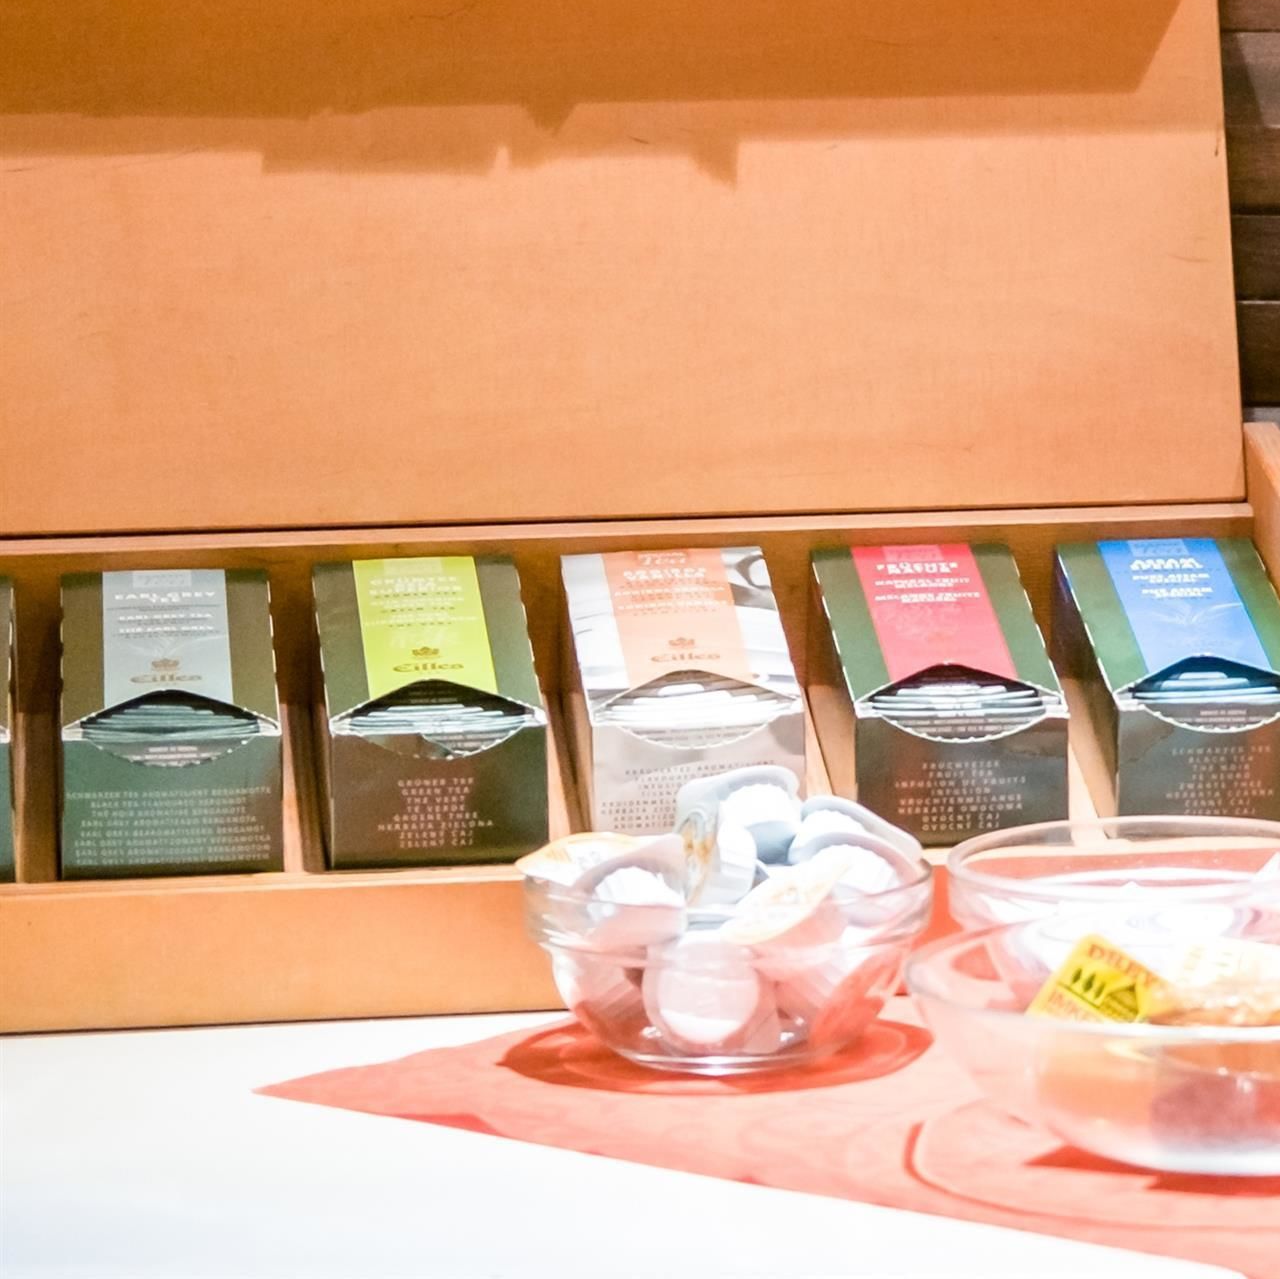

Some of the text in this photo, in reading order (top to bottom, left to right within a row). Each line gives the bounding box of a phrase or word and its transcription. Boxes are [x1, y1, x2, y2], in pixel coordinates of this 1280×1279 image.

[928, 770, 966, 778] FRUIT
[401, 786, 471, 796] GREEN TEA
[931, 787, 991, 796] INFUSION
[435, 795, 465, 804] VERT
[427, 804, 465, 813] VERDE
